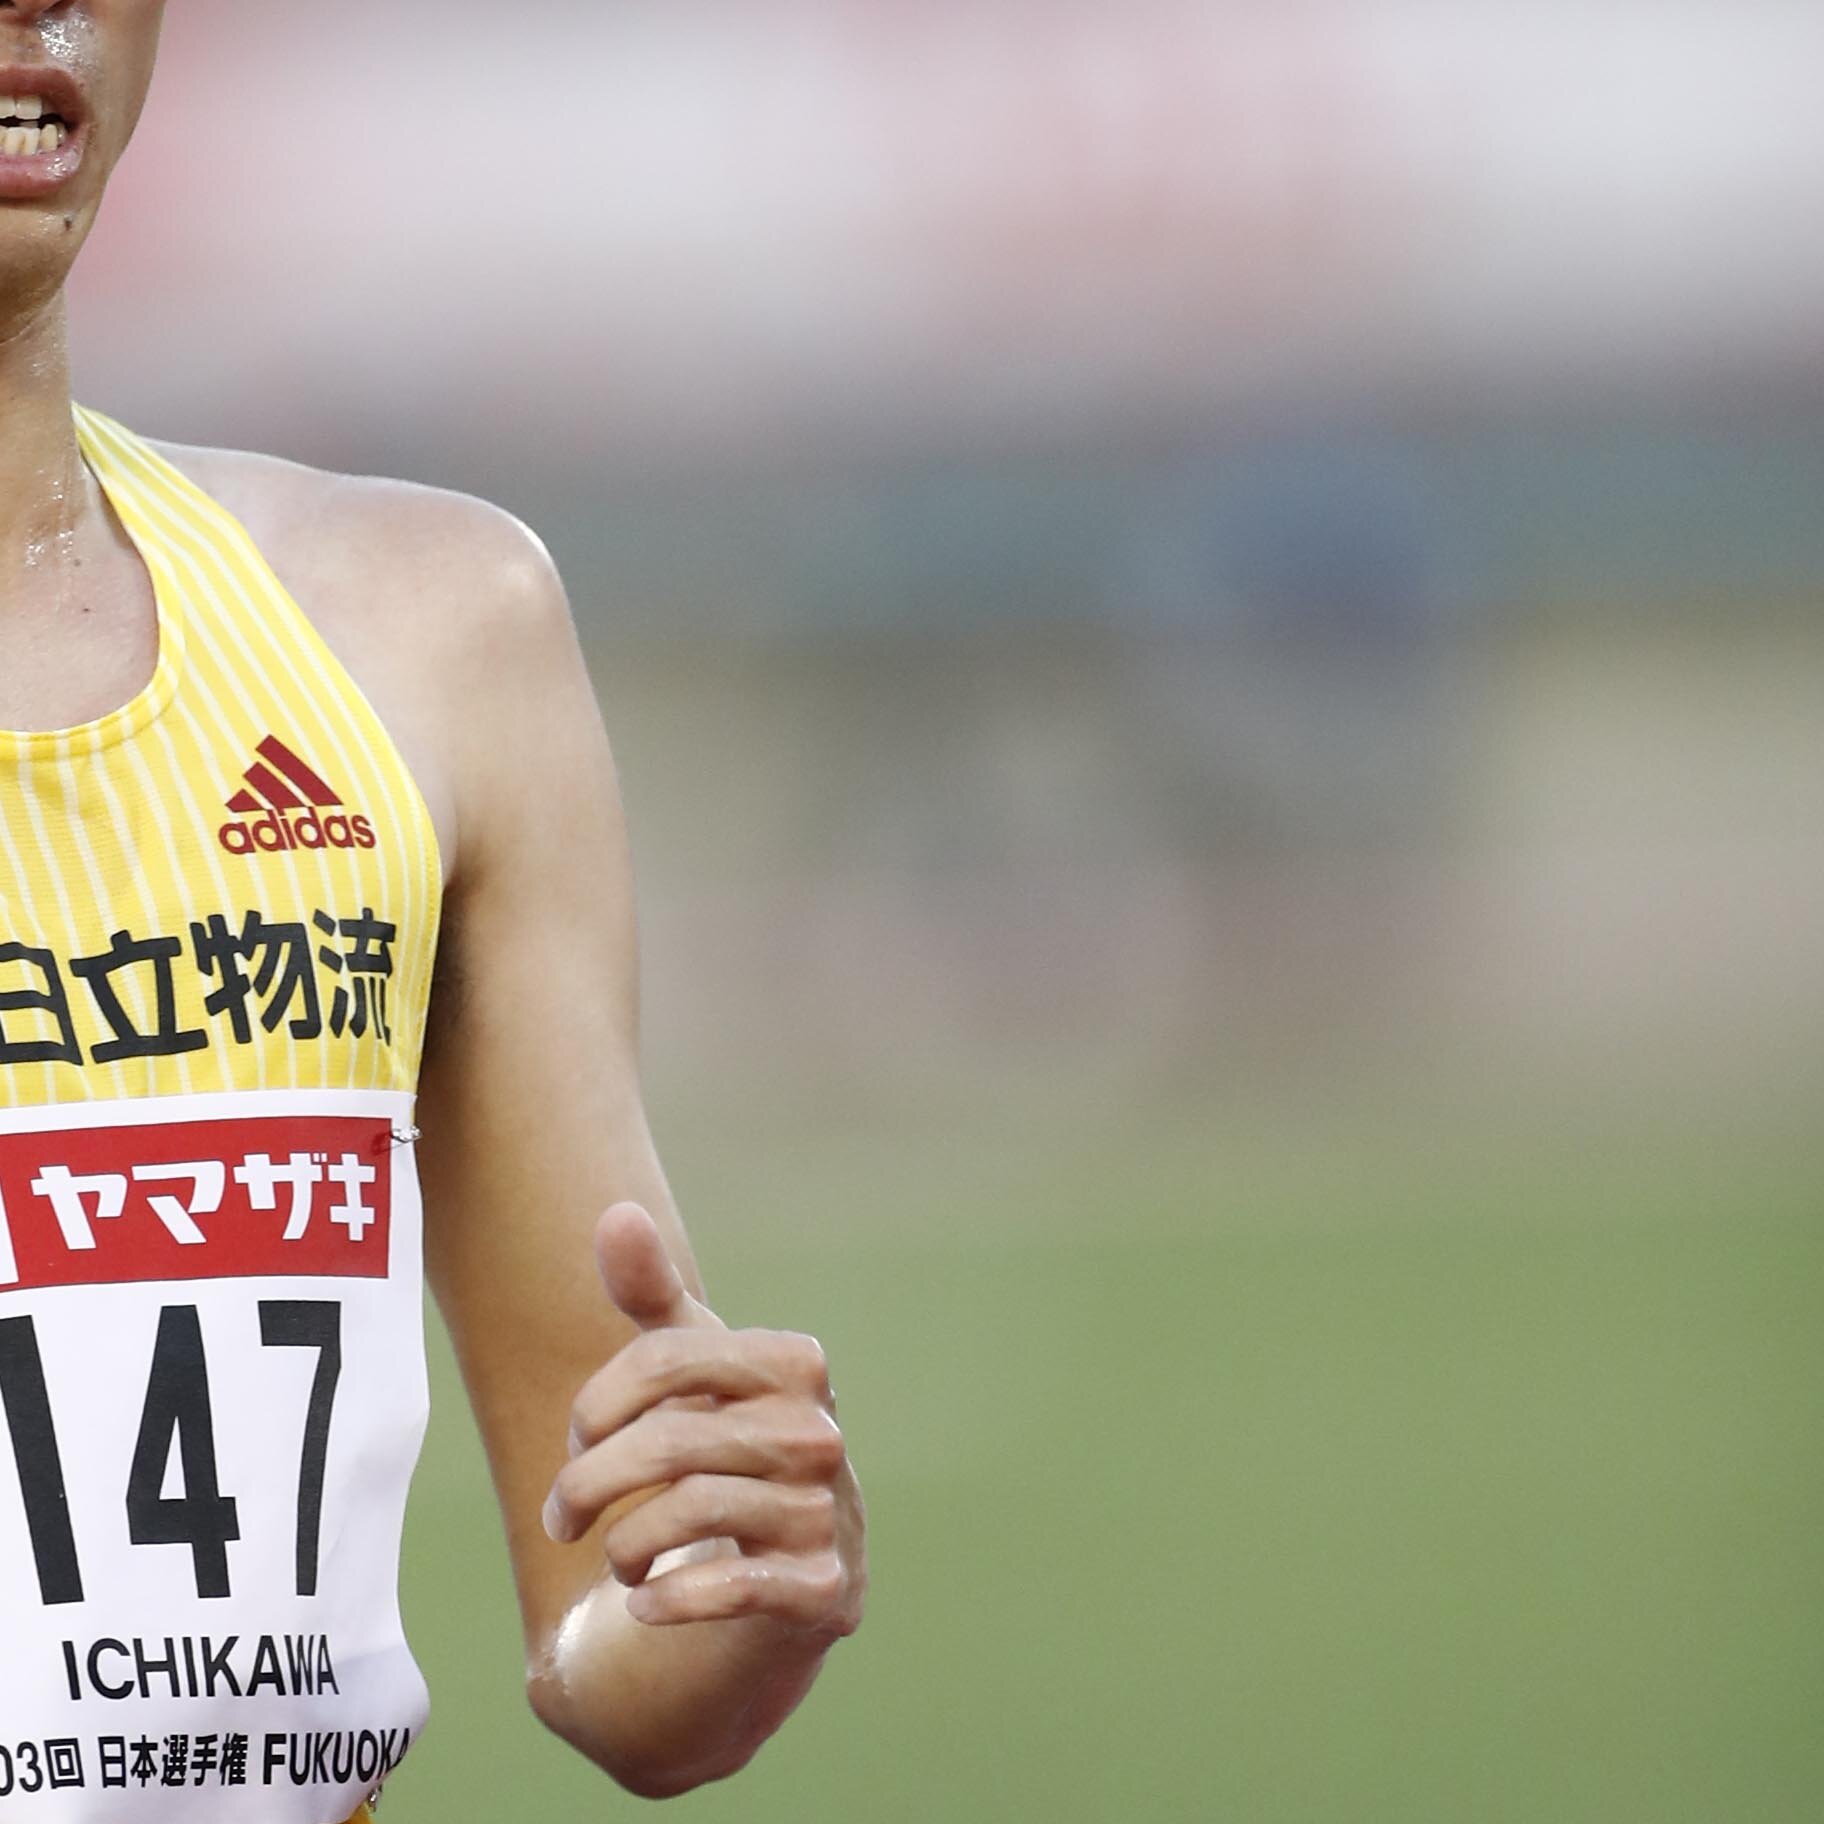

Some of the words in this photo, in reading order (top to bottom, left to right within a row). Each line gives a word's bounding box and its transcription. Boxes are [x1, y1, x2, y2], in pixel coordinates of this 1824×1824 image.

[218, 805, 376, 855] adidas
[31, 1152, 376, 1250] ヤマザキ
[61, 1634, 340, 1701] ICHIKAWA
[96, 1732, 249, 1789] 日本選手権
